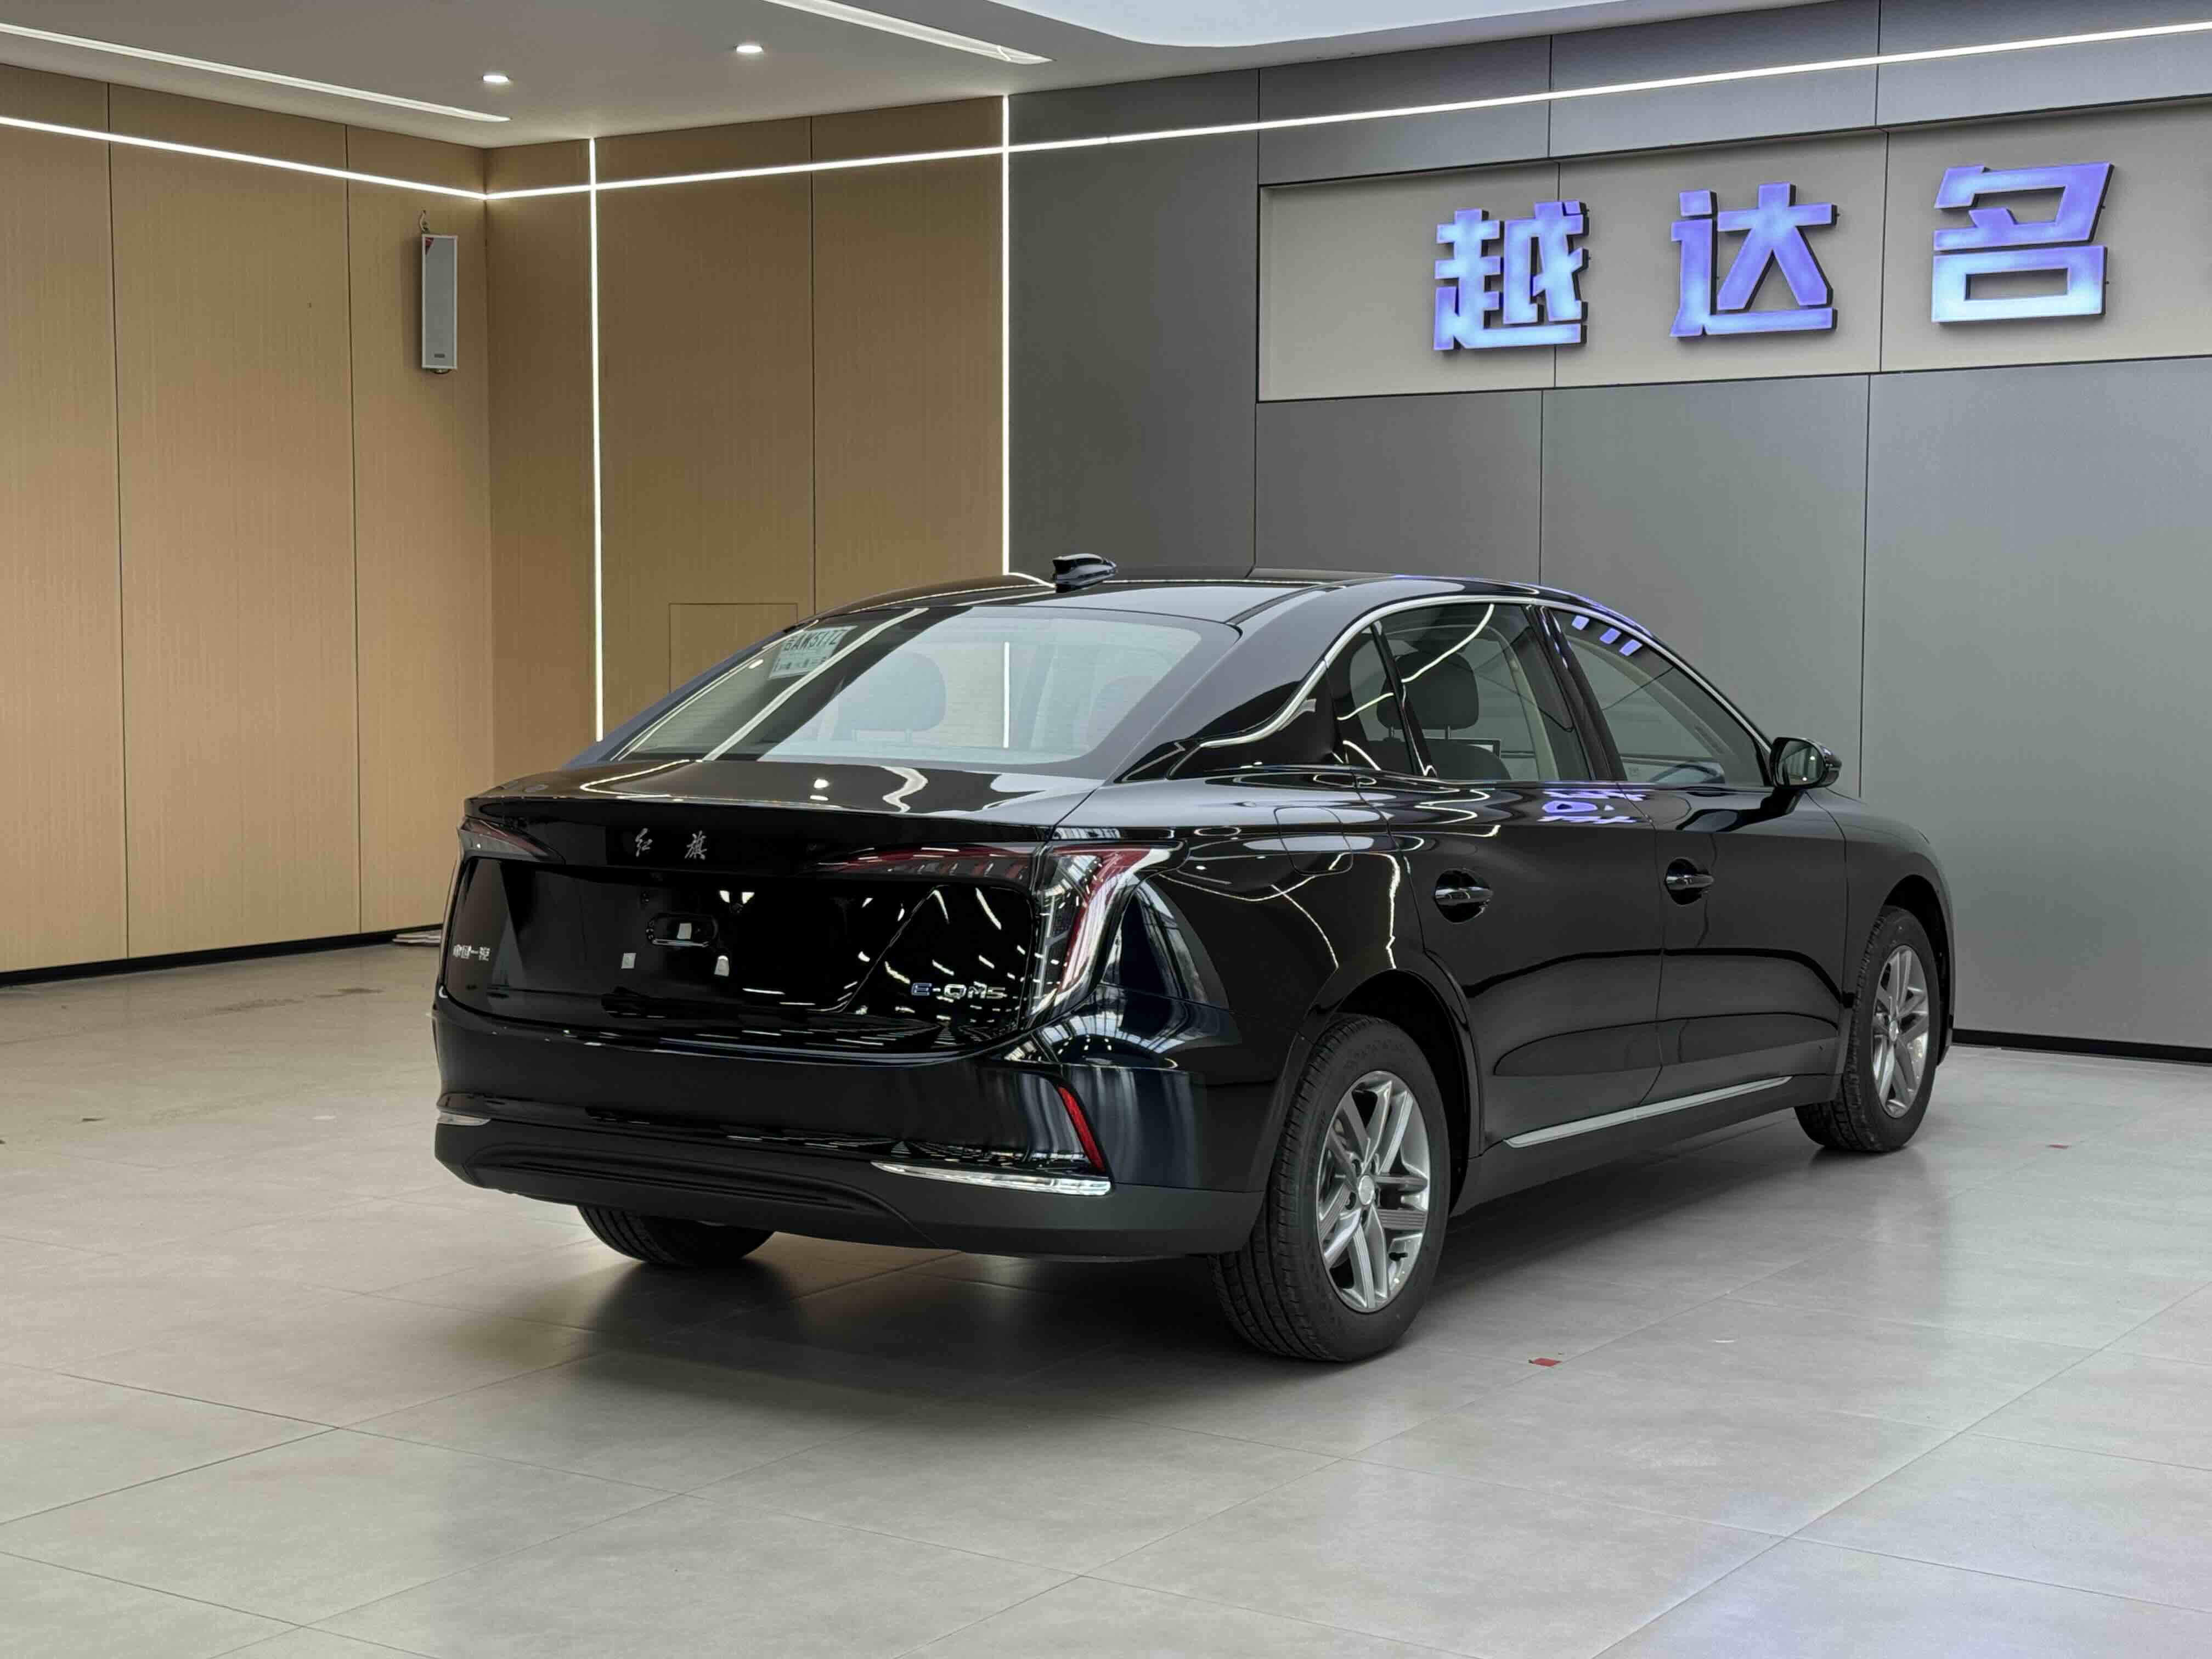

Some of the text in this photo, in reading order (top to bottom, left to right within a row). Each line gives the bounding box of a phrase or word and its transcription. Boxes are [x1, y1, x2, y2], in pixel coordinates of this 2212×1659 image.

[1434, 162, 2113, 351] 越达名
[635, 828, 707, 860] 红旗
